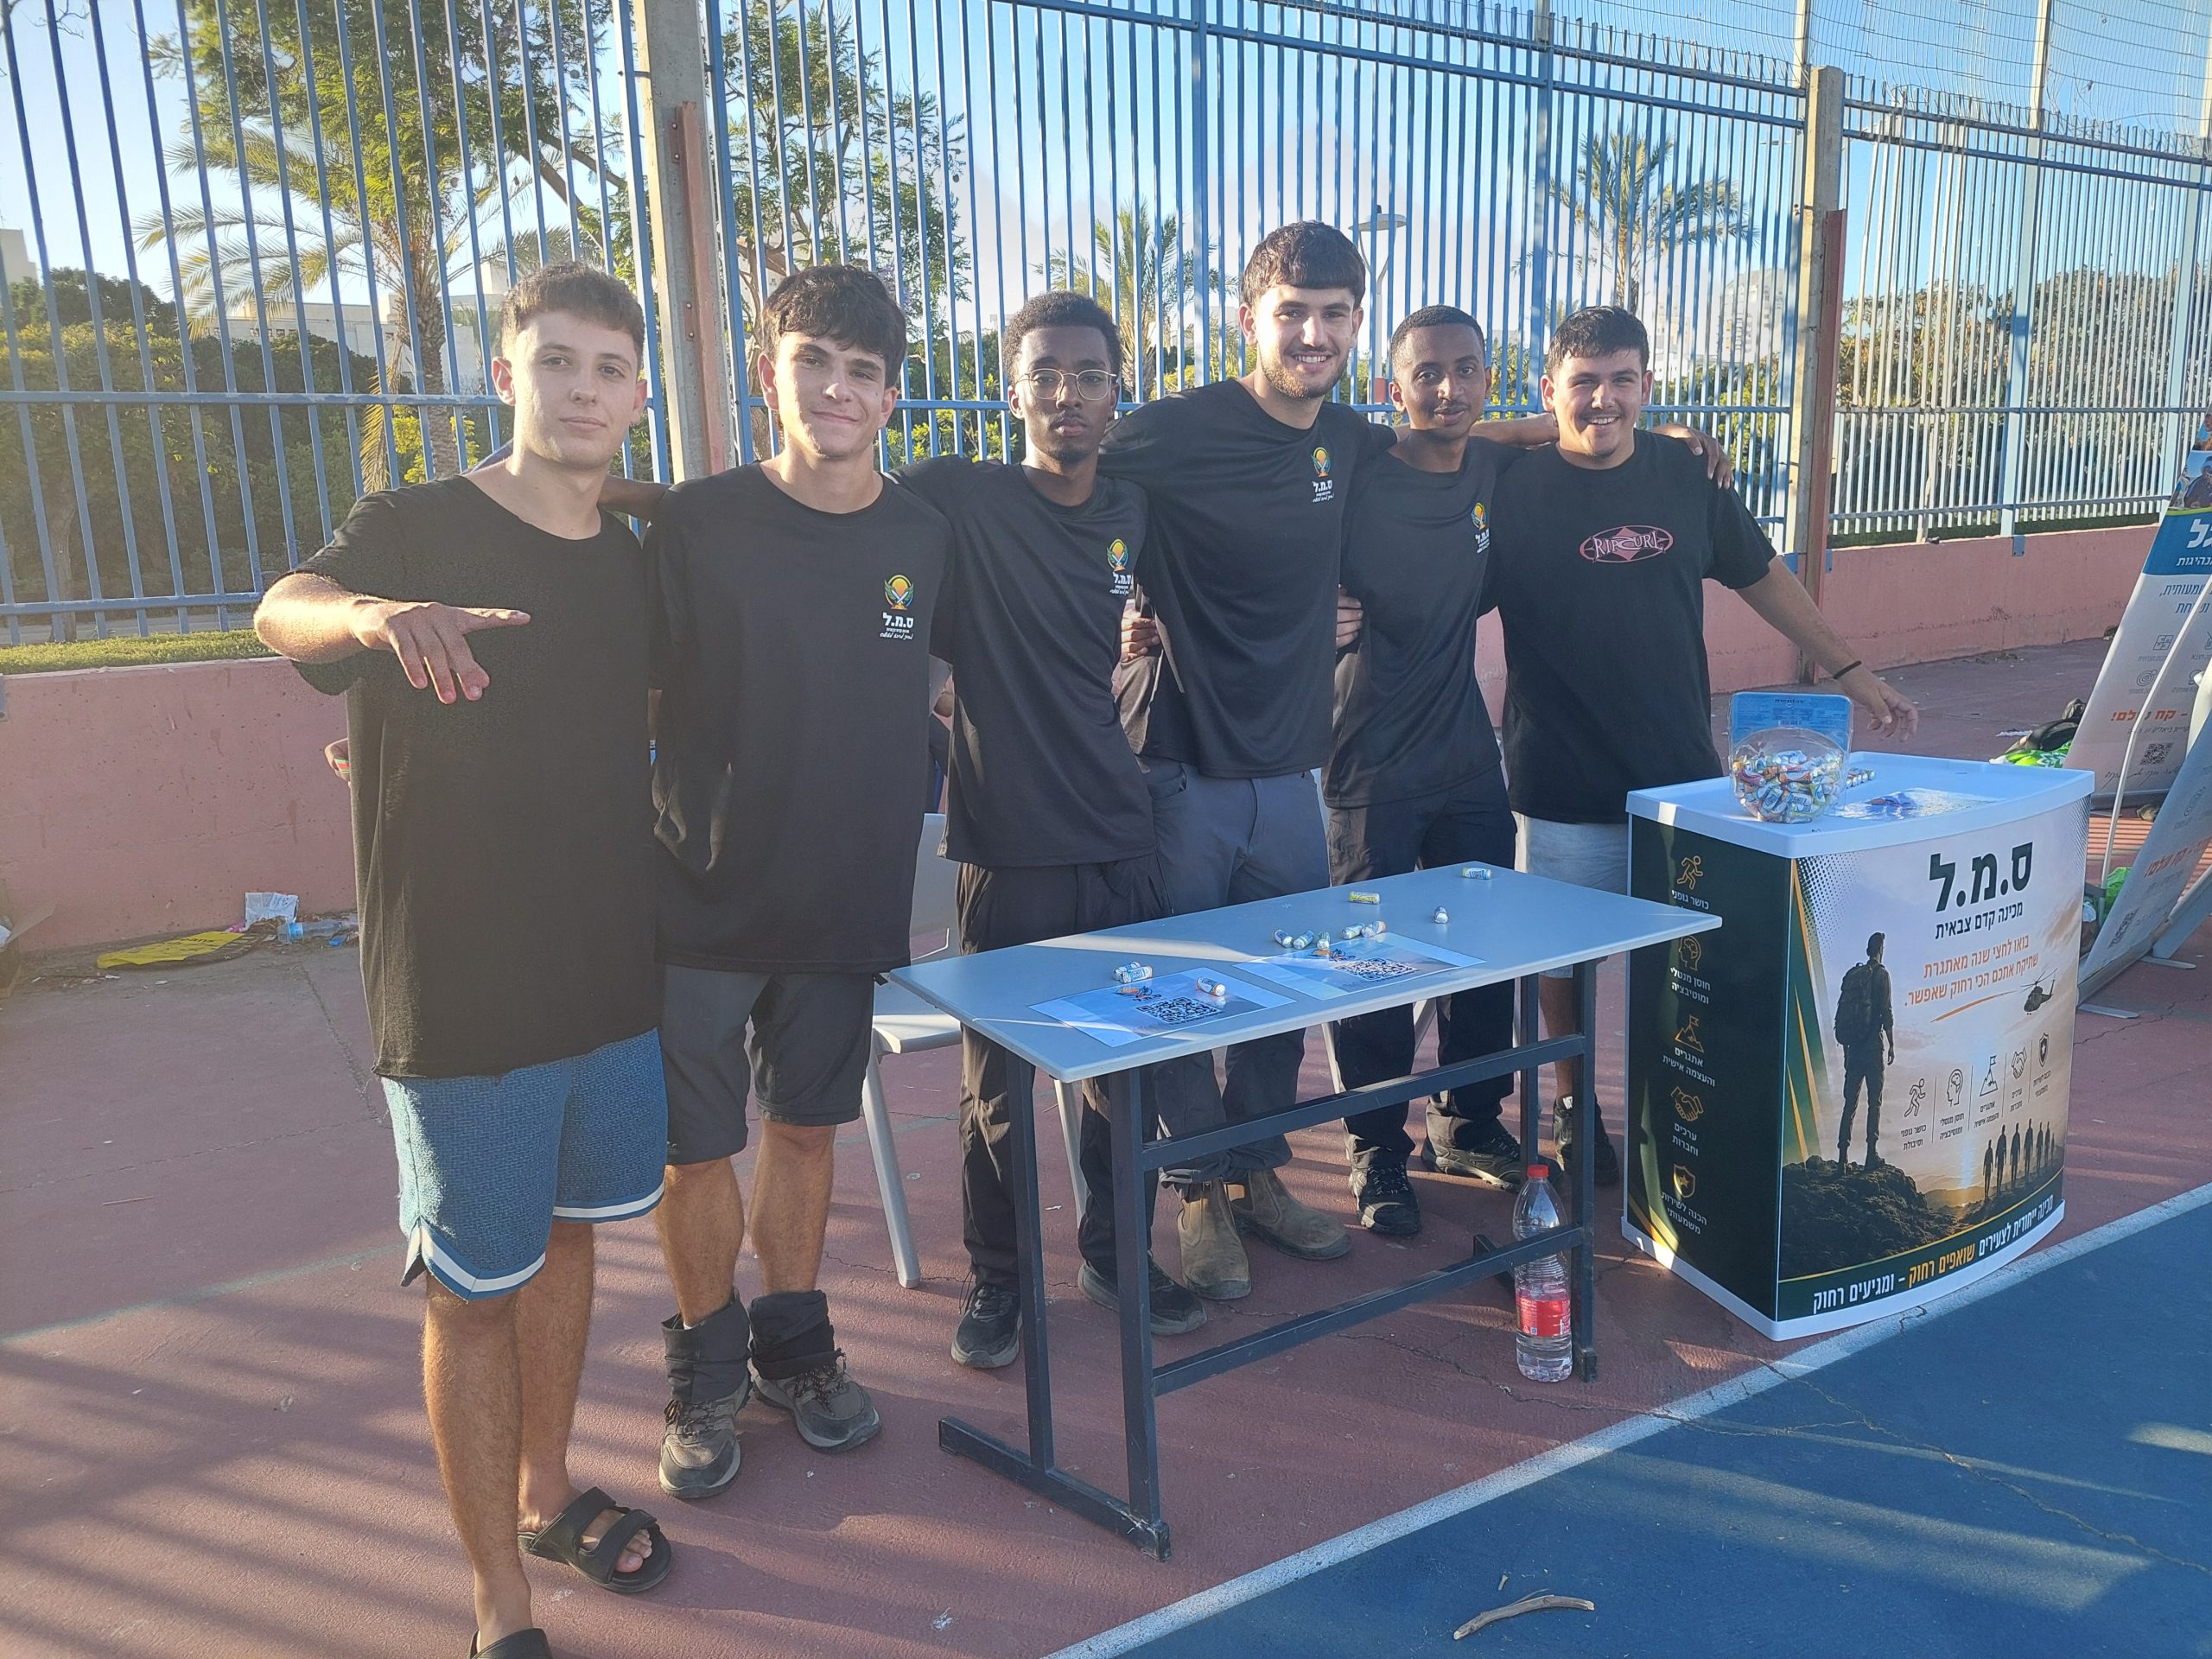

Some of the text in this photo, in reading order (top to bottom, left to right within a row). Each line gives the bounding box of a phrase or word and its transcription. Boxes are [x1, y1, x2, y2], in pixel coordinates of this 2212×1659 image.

[1593, 531, 1663, 559] RIP CURL
[882, 612, 914, 629] ס.מ.ל
[2155, 710, 2177, 721] קח
[1929, 842, 2033, 912] ס.מ.ל
[1672, 890, 1709, 910] כושר גופני
[1935, 901, 2023, 940] מכינה קדם צבאית
[1923, 935, 2029, 978] בואו לחצי שנה מאתגרת
[1670, 967, 1711, 991] חוסן מנטלי
[1671, 982, 1709, 1004] ומוטיבציה
[1904, 953, 2039, 1007] שתיקח אתכם הכי רחוק שאפשר.
[1662, 1055, 1715, 1087] והעצמה אישית
[1675, 1047, 1704, 1067] אתגרים
[1672, 1135, 1699, 1156] וחברות
[1675, 1122, 1697, 1141] ערכים
[1661, 1192, 1707, 1225] הכנה לשירות
[1667, 1207, 1700, 1235] משמעותי
[2012, 1208, 2037, 1237] ייחודית
[1979, 1222, 2012, 1256] לצעירים
[1938, 1243, 1975, 1274] שואפים
[1849, 1274, 1895, 1302] ומגיעים
[1908, 1260, 1935, 1289] רחוק
[1813, 1287, 1844, 1314] רחוק
